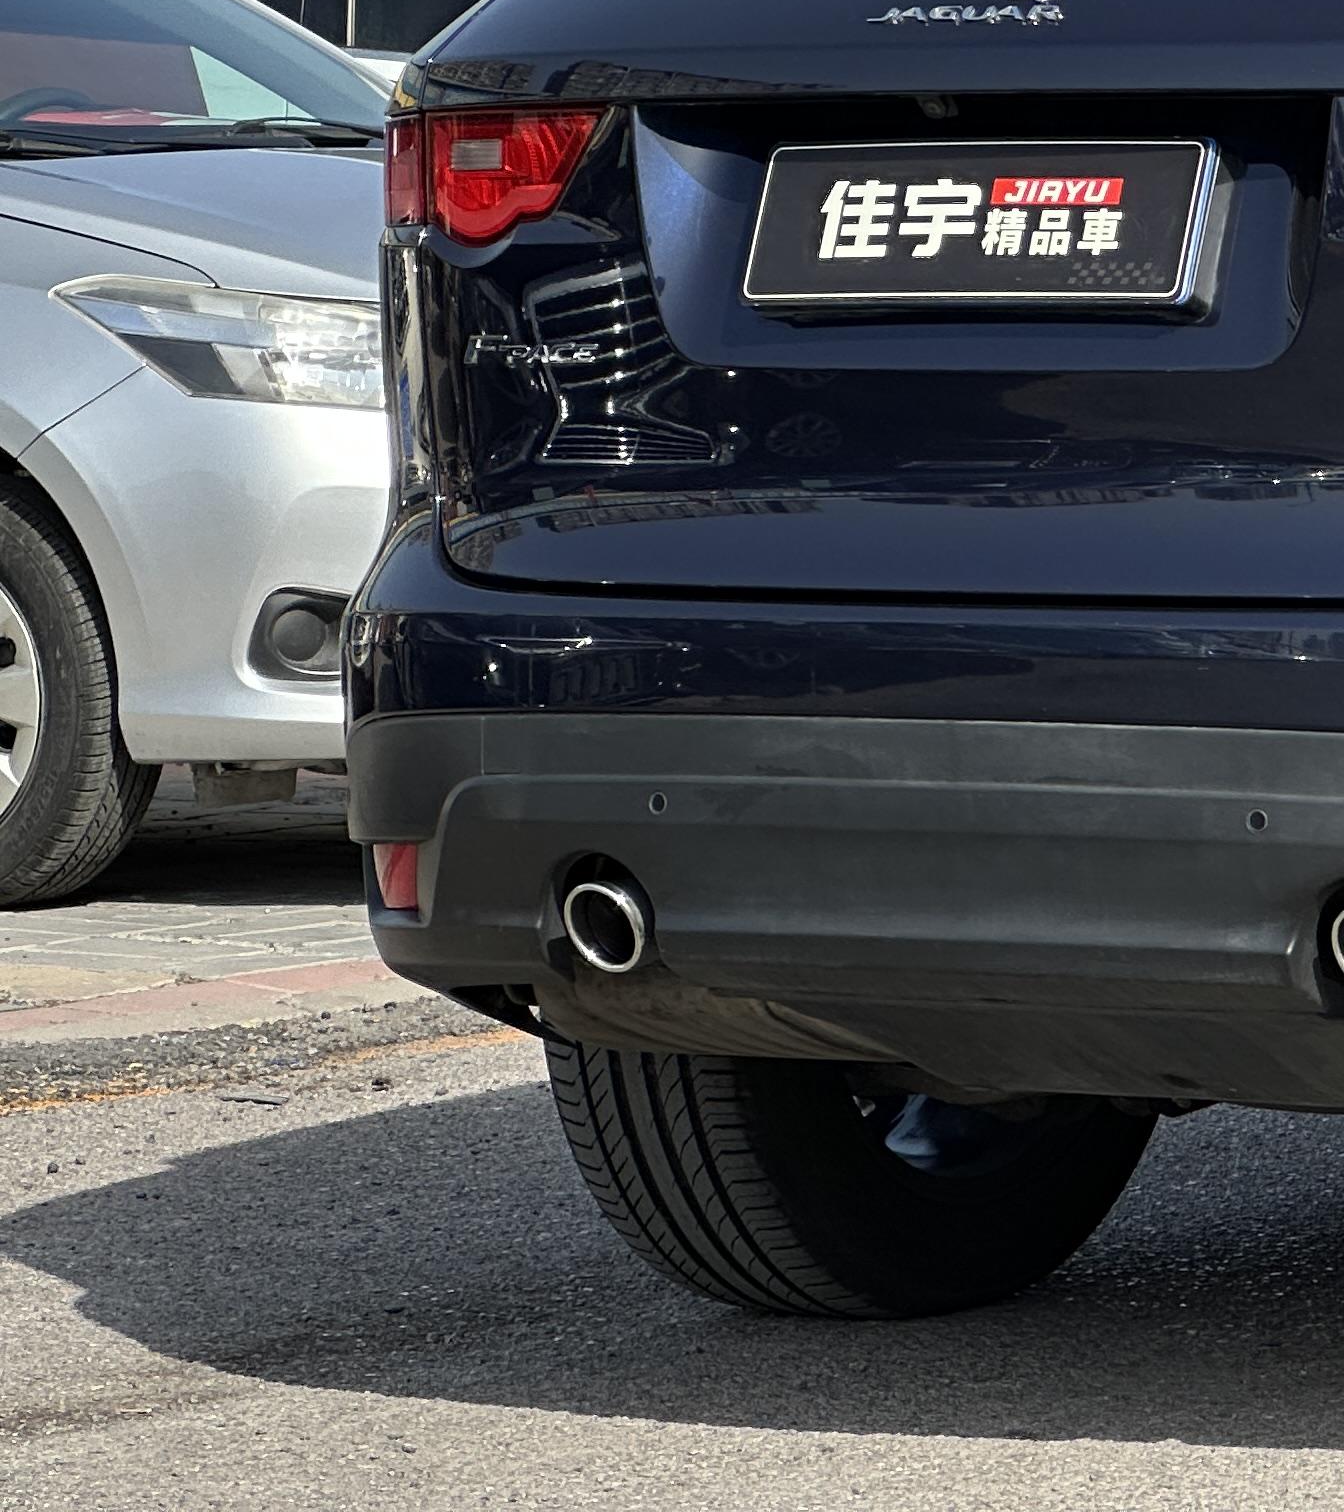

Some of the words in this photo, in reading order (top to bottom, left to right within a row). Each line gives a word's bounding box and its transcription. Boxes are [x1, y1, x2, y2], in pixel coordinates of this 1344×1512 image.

[866, 4, 1066, 25] JAGUAR
[1004, 180, 1111, 204] JIAYU
[817, 178, 982, 260] 佳宇
[980, 208, 1124, 257] 精品車
